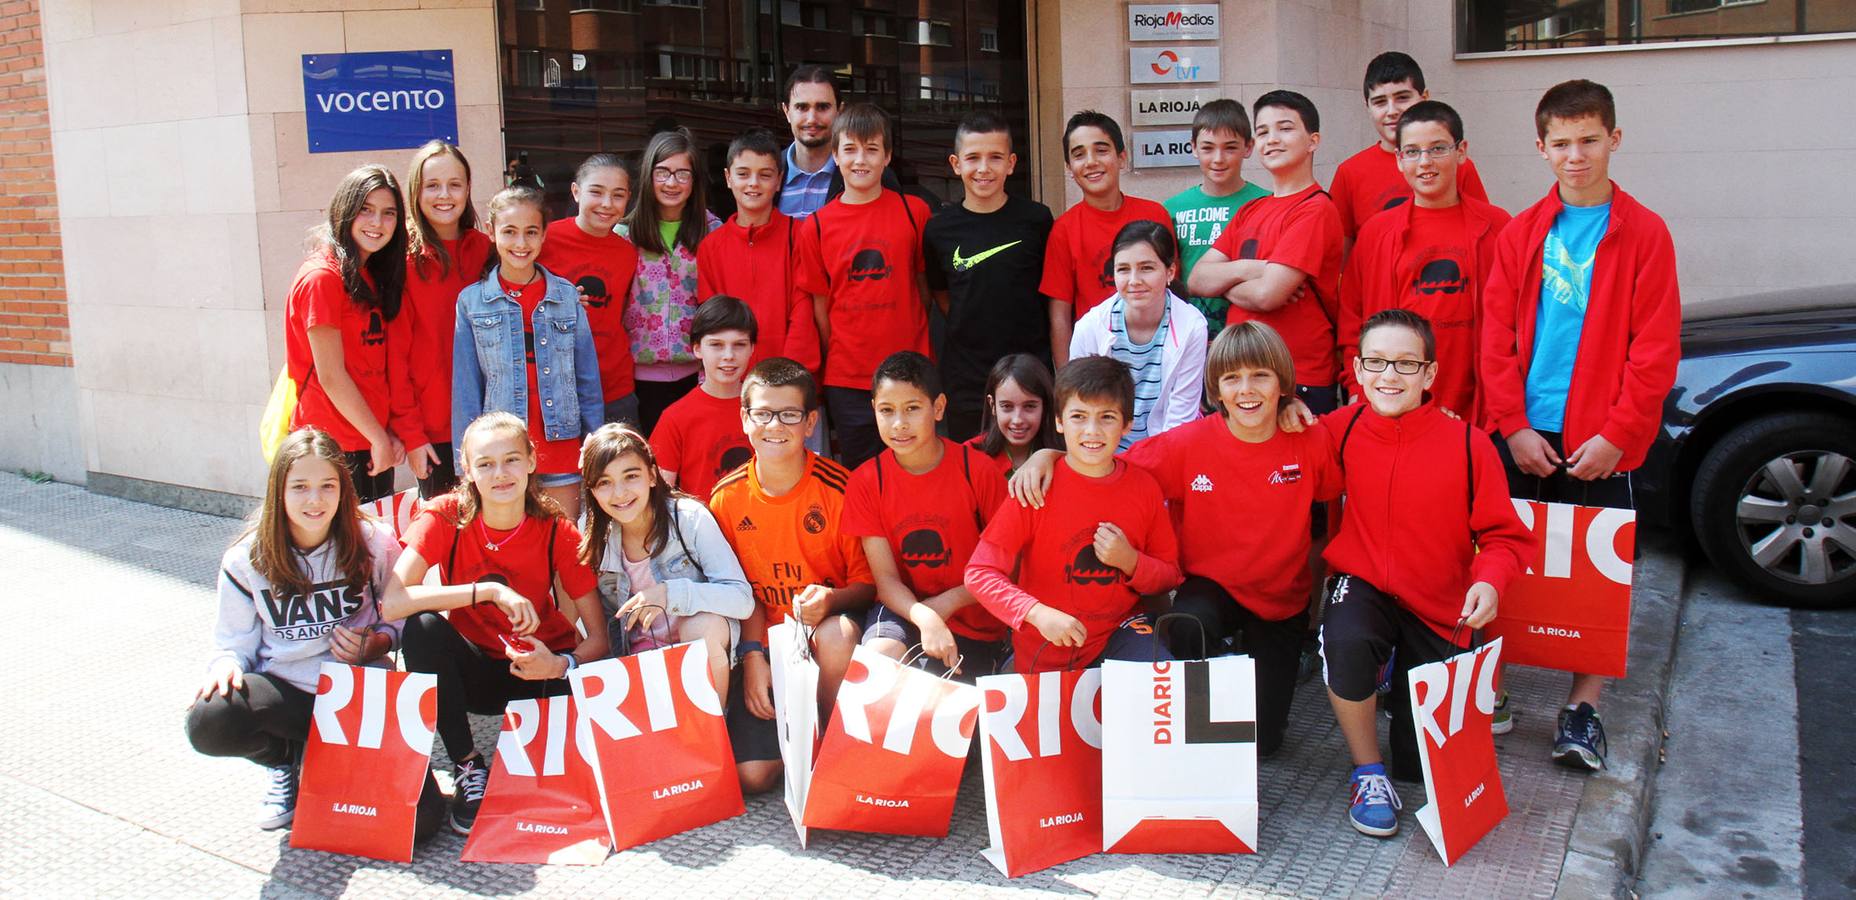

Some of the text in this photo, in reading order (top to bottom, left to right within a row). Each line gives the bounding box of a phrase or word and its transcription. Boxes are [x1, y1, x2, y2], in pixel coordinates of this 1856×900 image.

[1134, 11, 1214, 30] RiojaMedios
[1175, 63, 1200, 80] tvr
[316, 89, 444, 113] vocento
[1139, 101, 1200, 113] LA RIOJA
[1144, 143, 1164, 156] LA
[1175, 206, 1230, 224] WELCOME
[1176, 223, 1188, 239] TO
[773, 562, 802, 582] Fly
[260, 584, 364, 628] VANS
[1530, 625, 1546, 635] LA
[1547, 627, 1581, 639] RIOJA
[655, 788, 671, 799] LA
[670, 780, 704, 796] RIOJA
[858, 795, 874, 805] LA
[875, 798, 909, 808] RIOJA
[335, 803, 348, 813] LA
[348, 804, 377, 817] RIOJA
[1042, 817, 1055, 828] LA
[1055, 812, 1084, 826] RIOJA
[518, 822, 534, 833] LA
[534, 824, 569, 835] RIOJA
